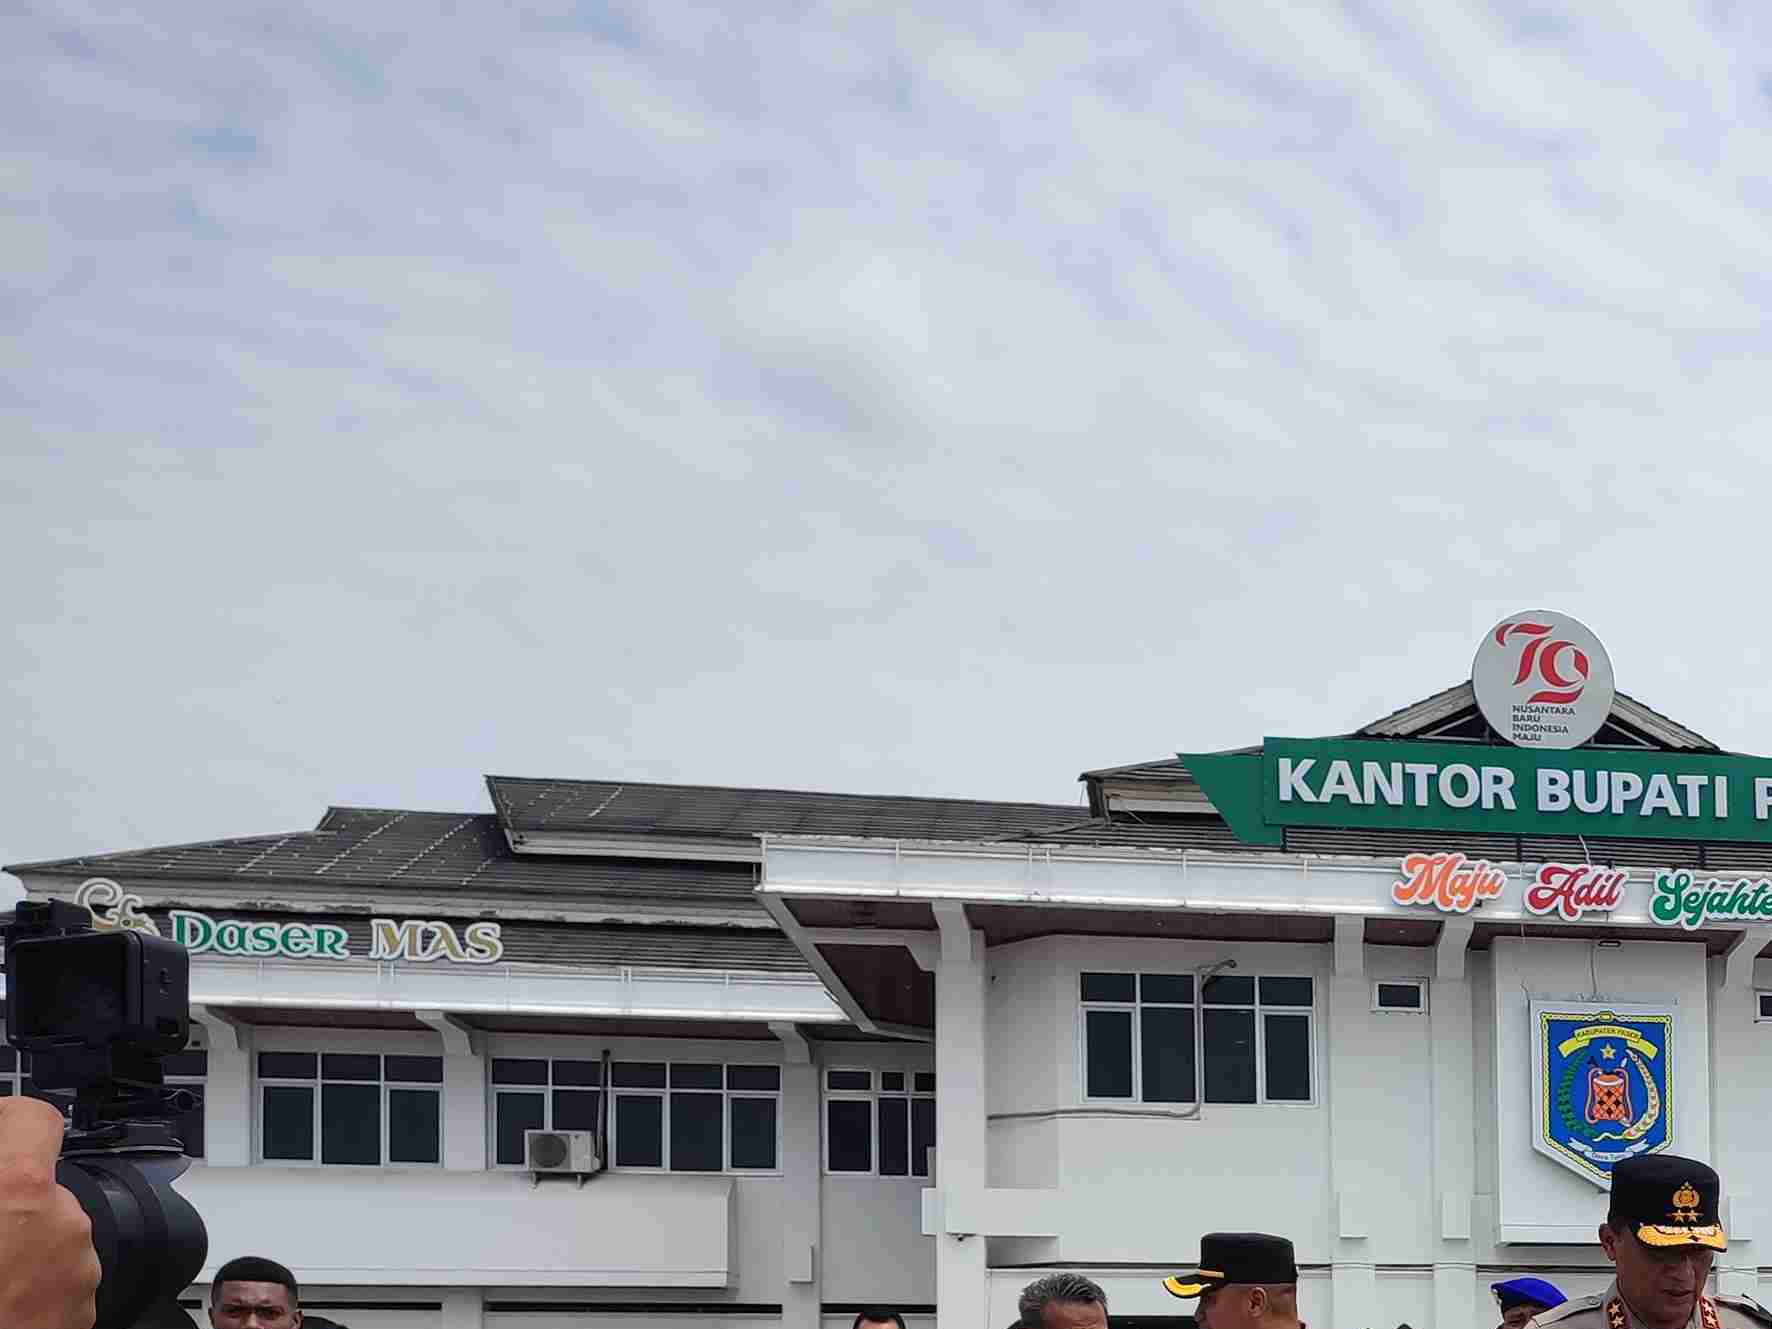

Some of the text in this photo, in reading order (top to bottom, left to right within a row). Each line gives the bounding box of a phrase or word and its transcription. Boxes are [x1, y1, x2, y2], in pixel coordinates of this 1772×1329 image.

[1495, 622, 1589, 704] 79
[1512, 704, 1576, 716] NUSANTARA
[1512, 714, 1541, 723] BARU
[1512, 724, 1569, 734] INDONESIA
[1512, 732, 1542, 742] MAJU
[1278, 758, 1517, 811] KANTOR
[1536, 768, 1729, 819] BUPATI
[1393, 854, 1506, 909] Maju
[1528, 866, 1627, 918] Adil
[371, 918, 501, 961] MAS
